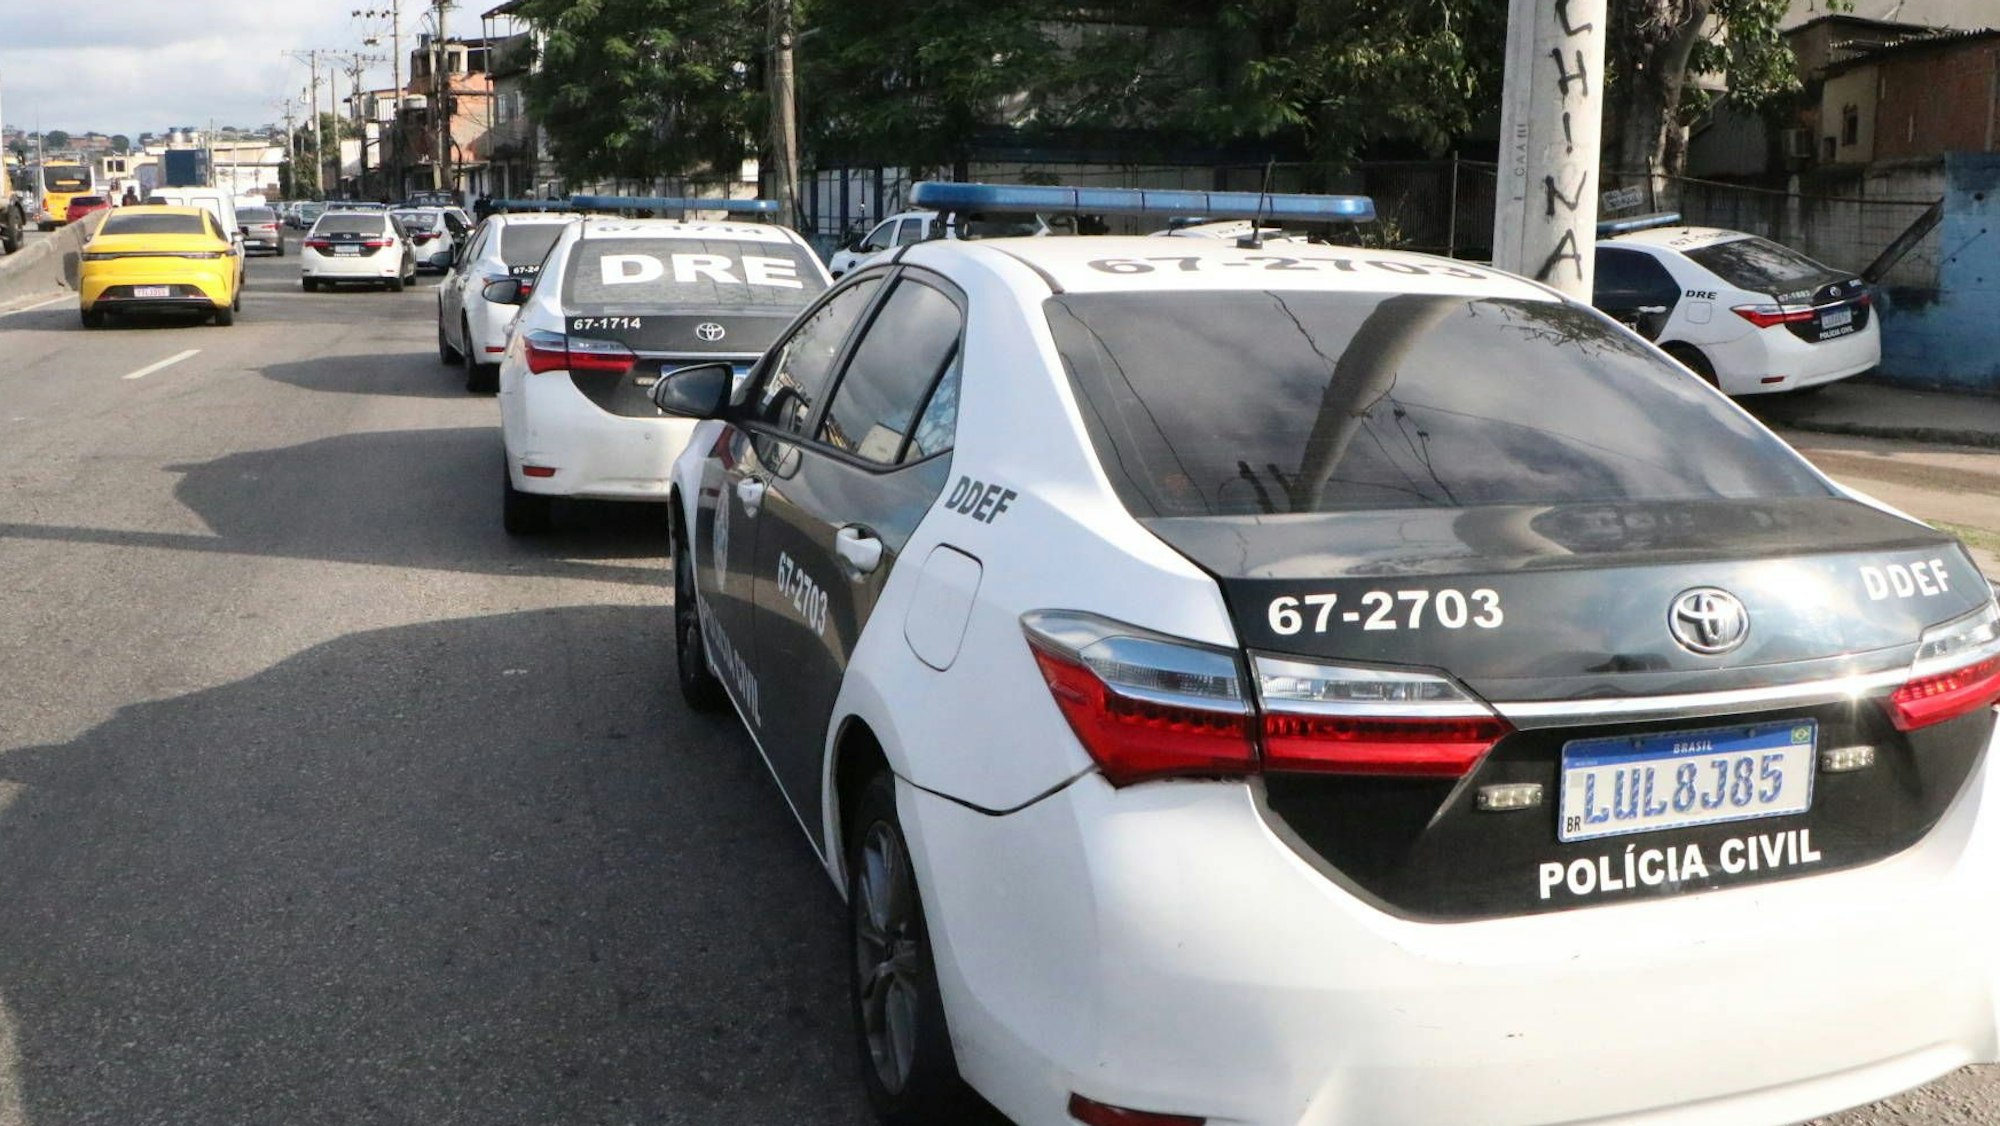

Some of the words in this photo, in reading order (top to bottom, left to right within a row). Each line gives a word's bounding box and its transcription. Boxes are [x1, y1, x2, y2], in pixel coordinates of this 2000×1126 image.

[601, 253, 803, 288] DRE
[1088, 255, 1489, 281] 67-2703
[1685, 289, 1717, 300] DRE
[573, 317, 641, 331] 67-1714
[945, 476, 1018, 525] DDEF
[777, 551, 828, 637] 67-2703
[1860, 557, 1950, 602] DDEF
[1267, 588, 1505, 636] 67-2703
[1672, 740, 1713, 754] BRASIL
[1584, 754, 1784, 824] LUL8J85
[1566, 816, 1581, 833] BR
[1539, 843, 1709, 900] POLÍCIA
[1719, 828, 1822, 875] CIVIL
